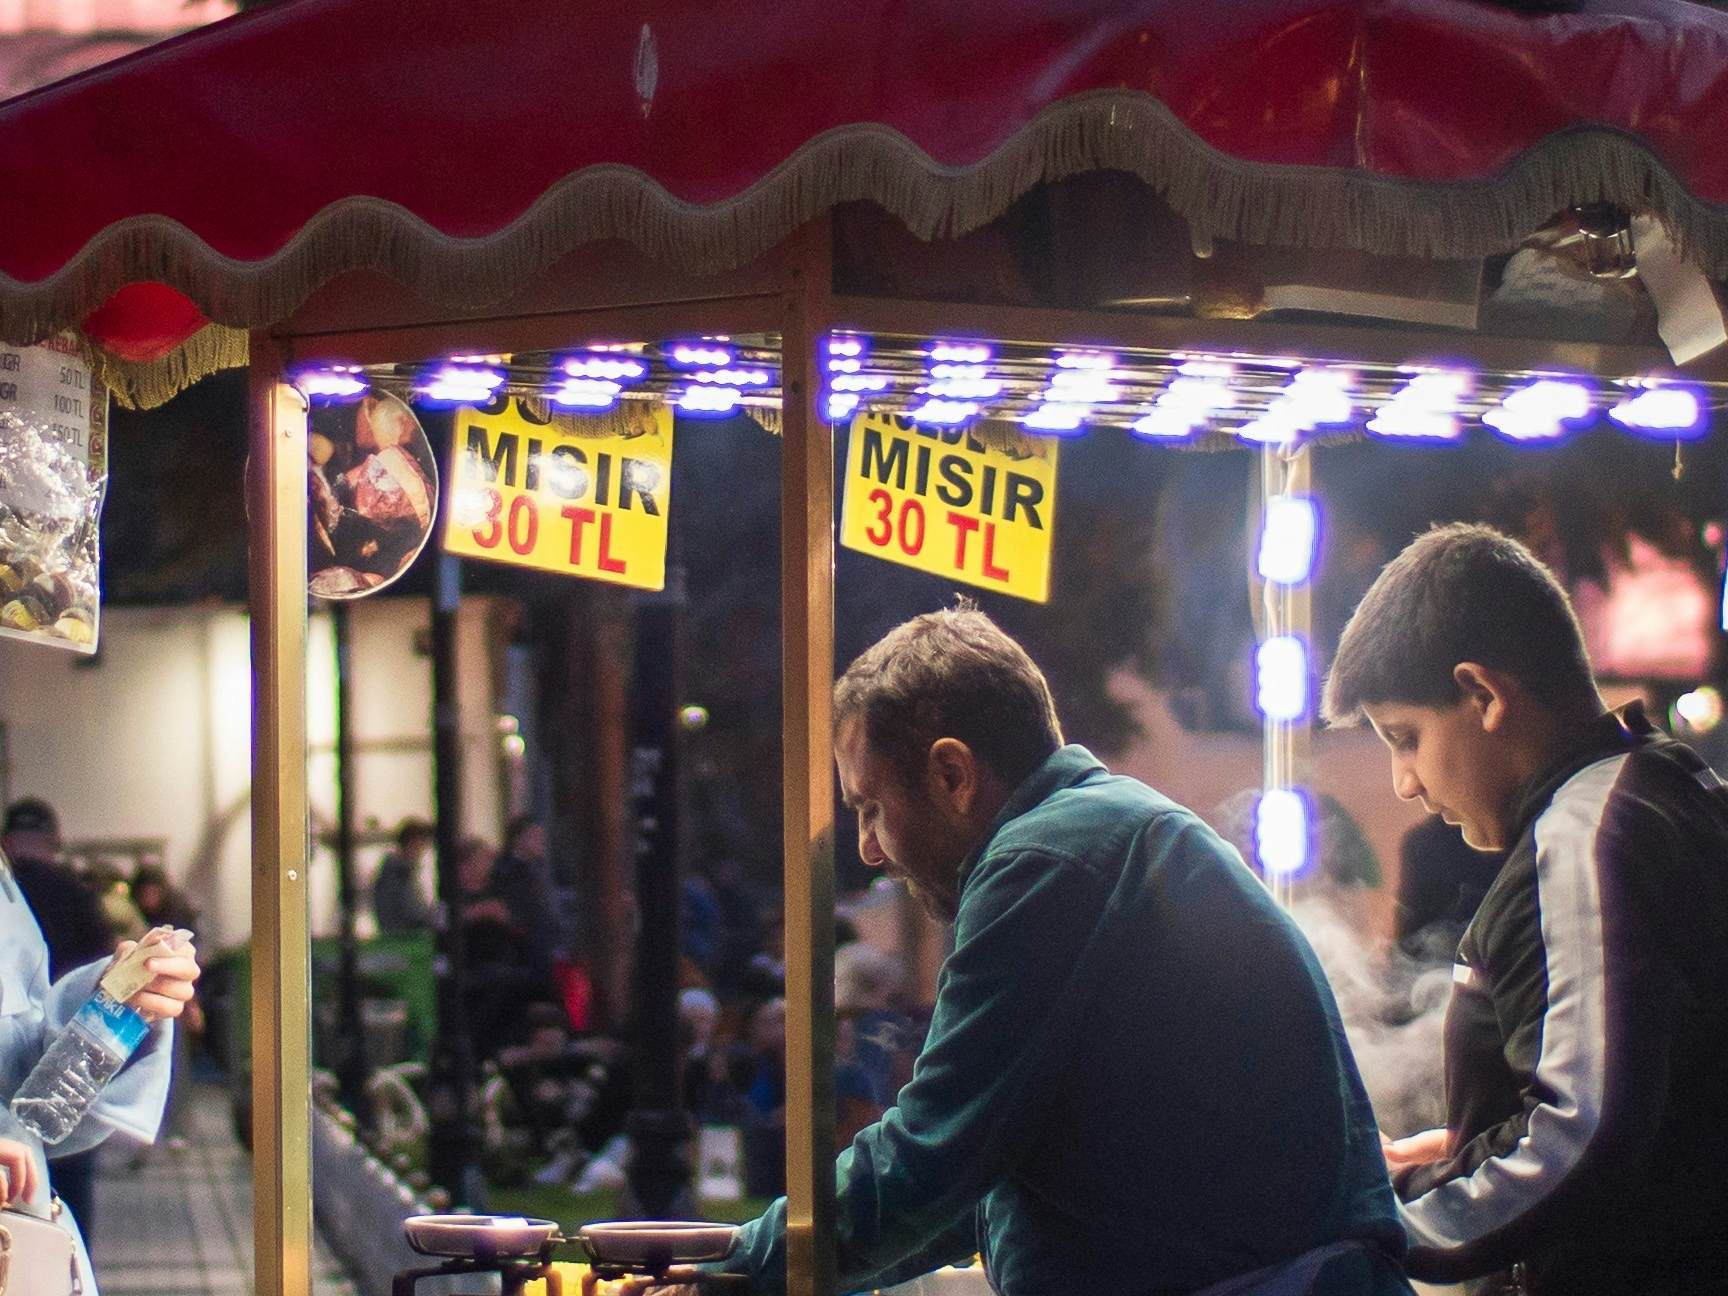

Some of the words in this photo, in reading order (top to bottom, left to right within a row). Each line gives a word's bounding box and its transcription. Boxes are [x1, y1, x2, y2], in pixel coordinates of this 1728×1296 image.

[53, 394, 72, 415] 100
[72, 398, 85, 419] TL
[73, 369, 86, 390] TL
[467, 424, 661, 517] MISIR
[860, 426, 1045, 531] MISIR
[471, 487, 539, 556] 30
[560, 504, 627, 575] TL
[865, 487, 926, 556] 30
[946, 510, 1010, 583] TL
